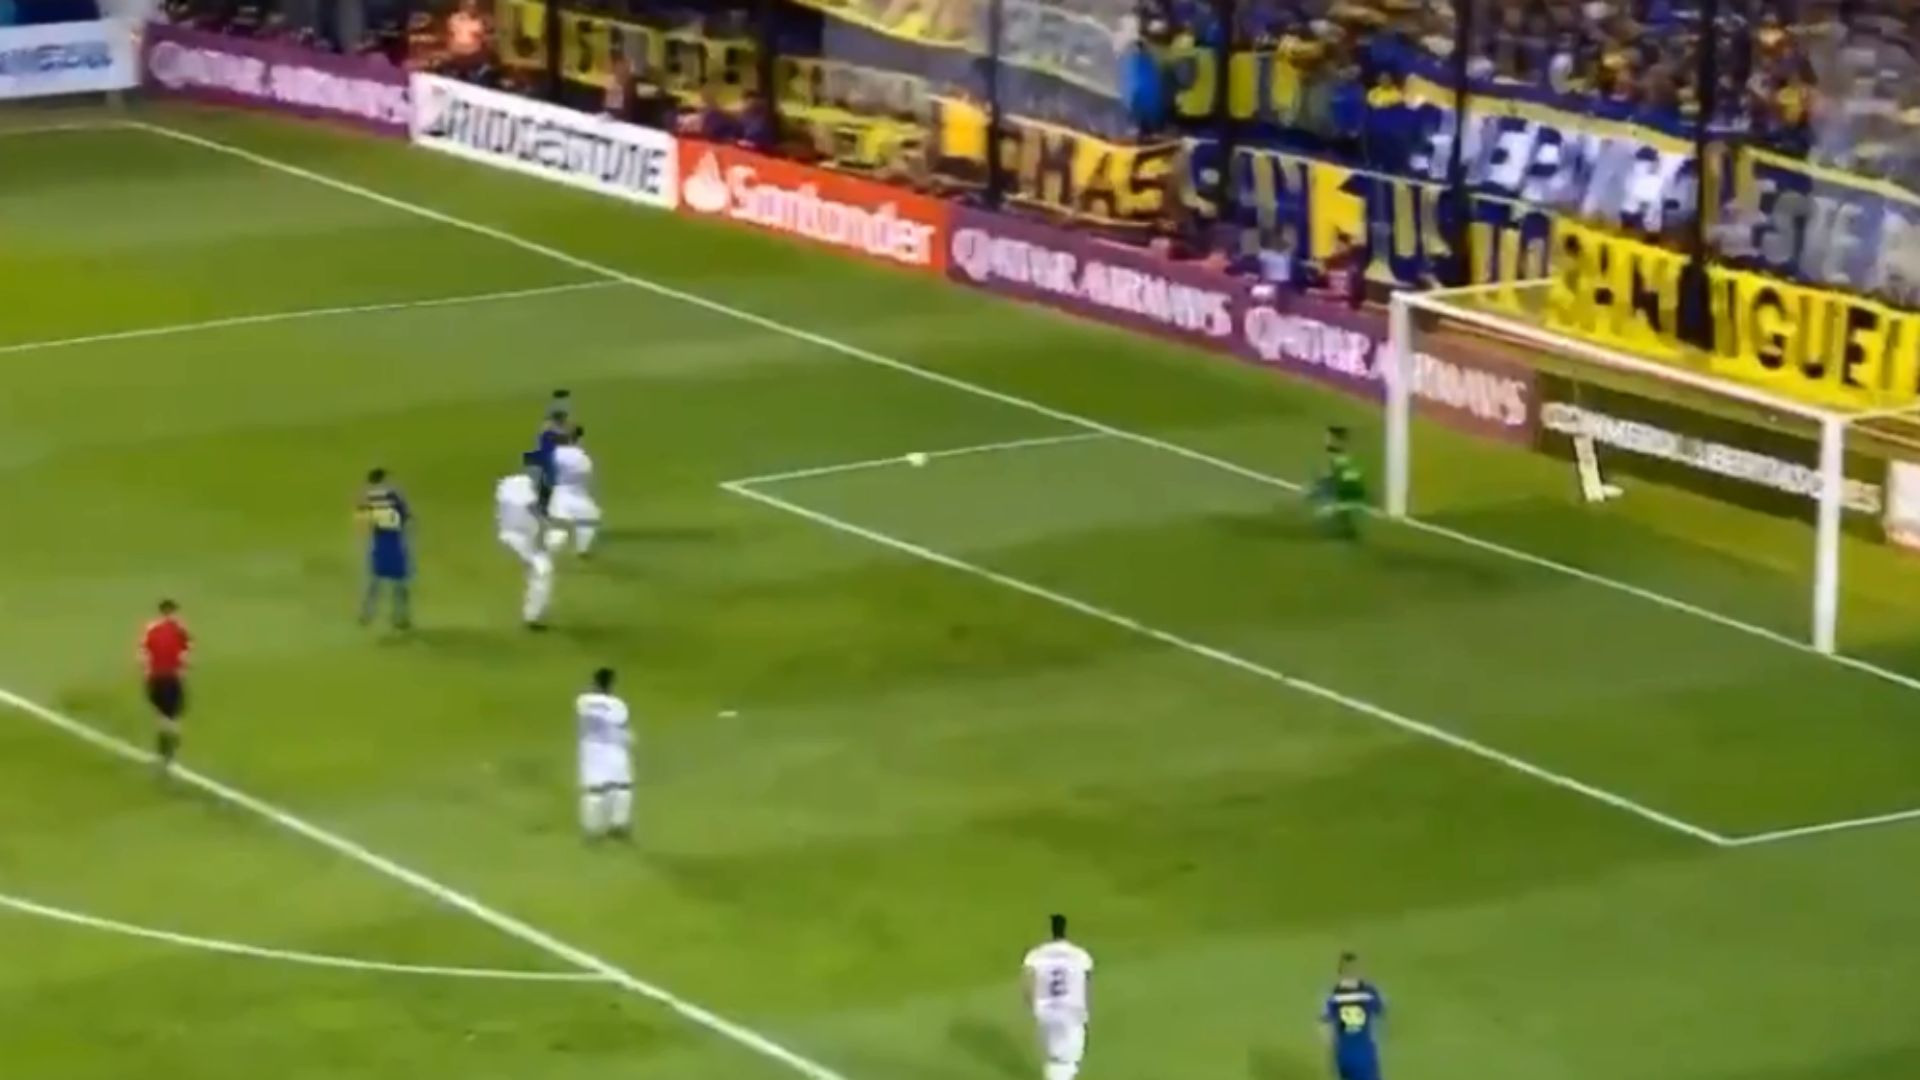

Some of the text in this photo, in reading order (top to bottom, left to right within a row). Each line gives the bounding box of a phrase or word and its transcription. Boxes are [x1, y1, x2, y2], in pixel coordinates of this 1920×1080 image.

[726, 164, 936, 266] Santander
[951, 228, 1232, 336] QATAR AIRWAYS
[1244, 306, 1369, 376] QATAR
